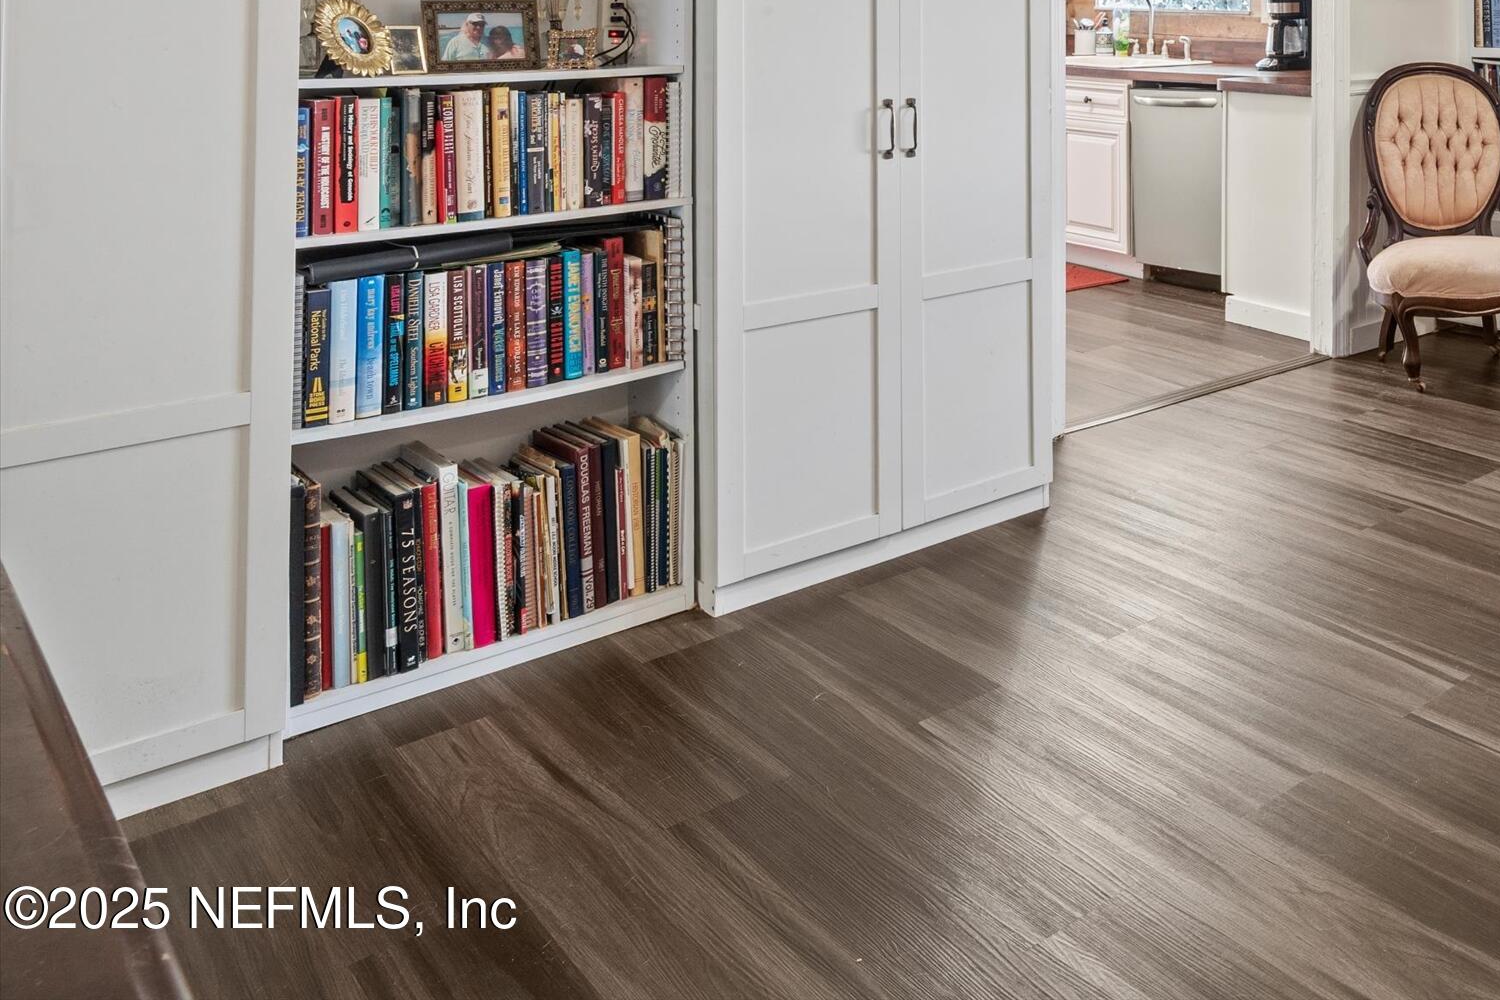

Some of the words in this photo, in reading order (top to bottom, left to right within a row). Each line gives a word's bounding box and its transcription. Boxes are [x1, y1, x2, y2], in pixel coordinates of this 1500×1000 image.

[321, 131, 331, 155] HISTORY
[320, 176, 330, 209] HOLOCAUST
[453, 275, 463, 293] LISA
[493, 269, 503, 289] Janet
[550, 263, 562, 300] MICHAEL
[568, 261, 581, 292] JANET
[365, 288, 376, 306] mary
[391, 285, 400, 299] LISA
[408, 279, 421, 316] DANIELLE
[428, 282, 440, 297] LISA
[365, 308, 378, 320] kay
[391, 299, 400, 312] LUTZ
[428, 298, 440, 331] GARDNER
[310, 310, 321, 346] National
[408, 319, 421, 343] STEEL
[453, 296, 463, 341] SCOTTOLINE
[513, 322, 521, 338] LAKE
[568, 295, 581, 353] EVANOVICH
[367, 322, 378, 349] andrews
[551, 322, 562, 364] CRICHTON
[309, 348, 320, 371] Parks
[408, 346, 417, 375] Southern
[429, 342, 445, 367] CATCH
[367, 357, 377, 379] beach
[389, 353, 398, 386] SPELLMANS
[368, 380, 376, 399] town
[407, 376, 417, 396] Lights
[580, 455, 591, 503] DOUGLAS
[567, 475, 575, 526] LONGWOOD
[401, 528, 414, 548] 75
[583, 506, 593, 555] FREEMAN
[569, 530, 577, 564] COLLEGE
[402, 556, 417, 633] SEASONS
[585, 577, 593, 596] Vol.
[586, 597, 595, 609] 29
